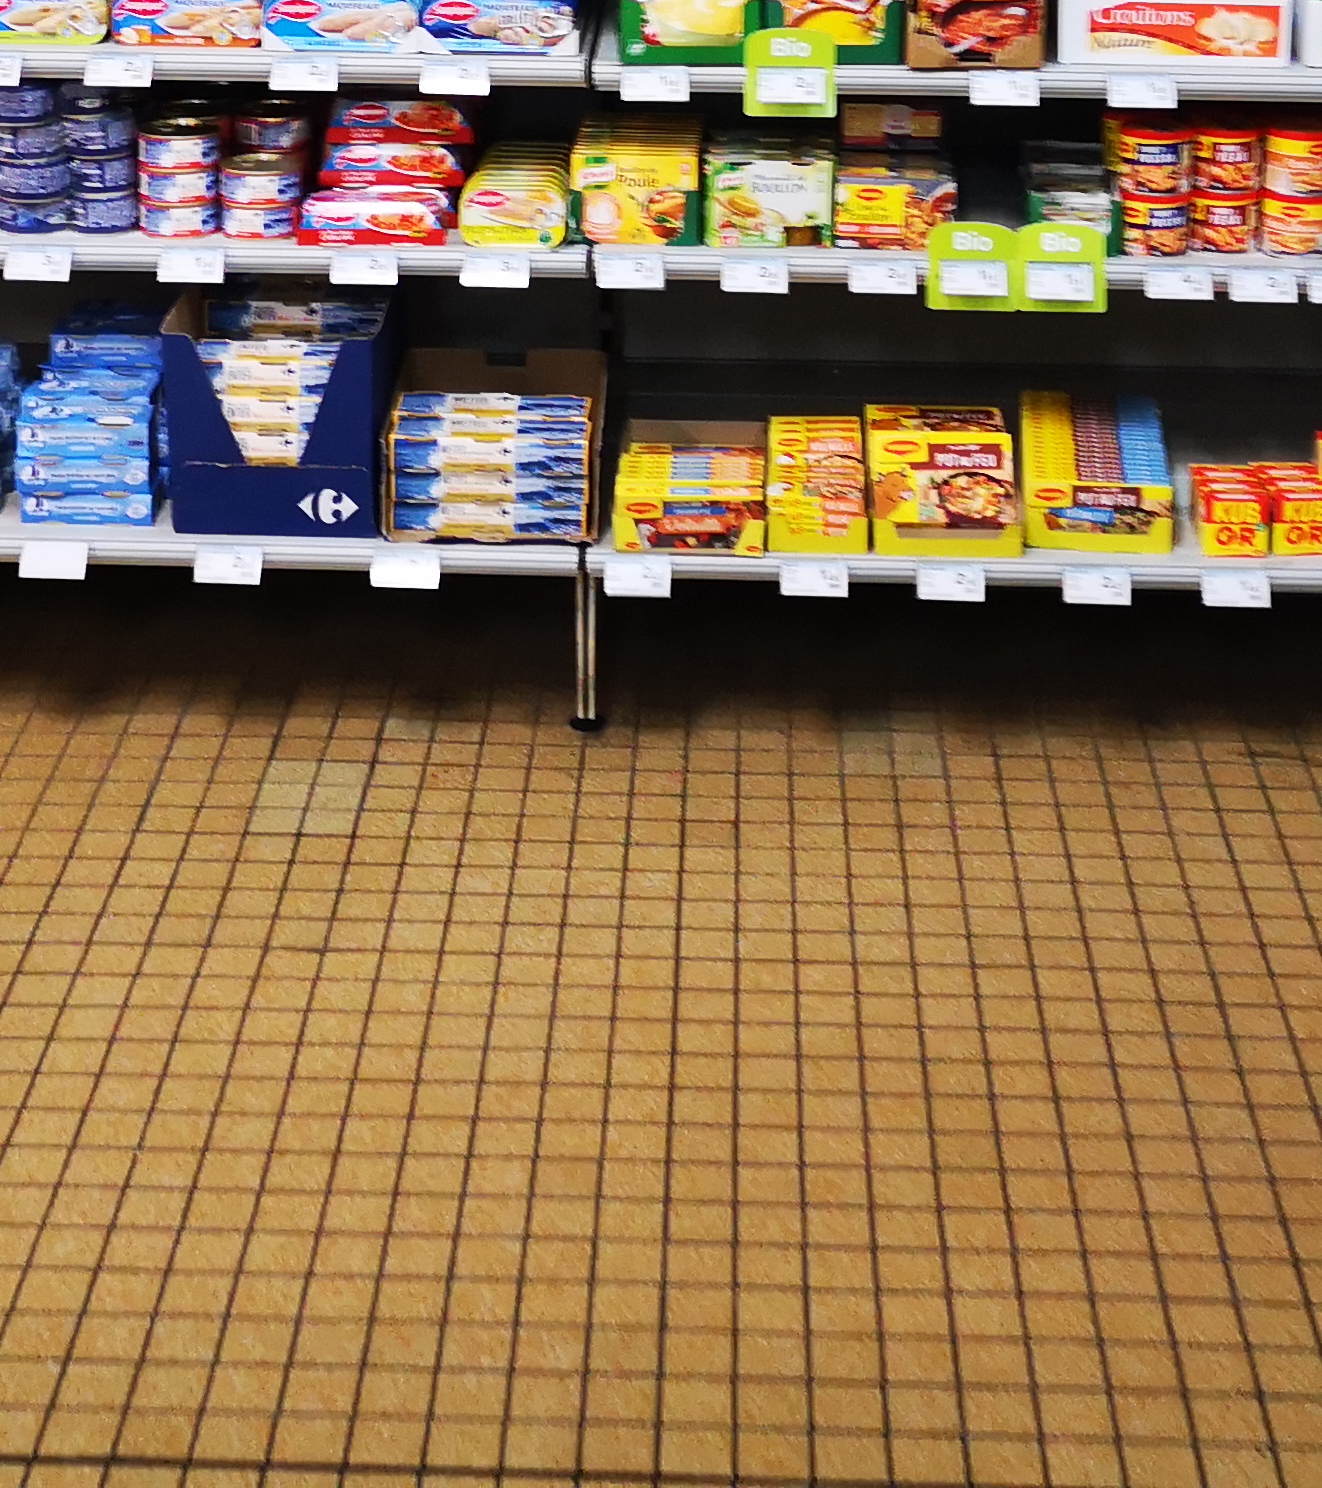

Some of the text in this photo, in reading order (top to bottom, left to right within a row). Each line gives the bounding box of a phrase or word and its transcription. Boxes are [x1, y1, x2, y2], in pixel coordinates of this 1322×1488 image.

[770, 35, 812, 57] Bio
[952, 231, 994, 252] Bio
[1039, 231, 1082, 252] Bio
[1216, 526, 1254, 548] OR
